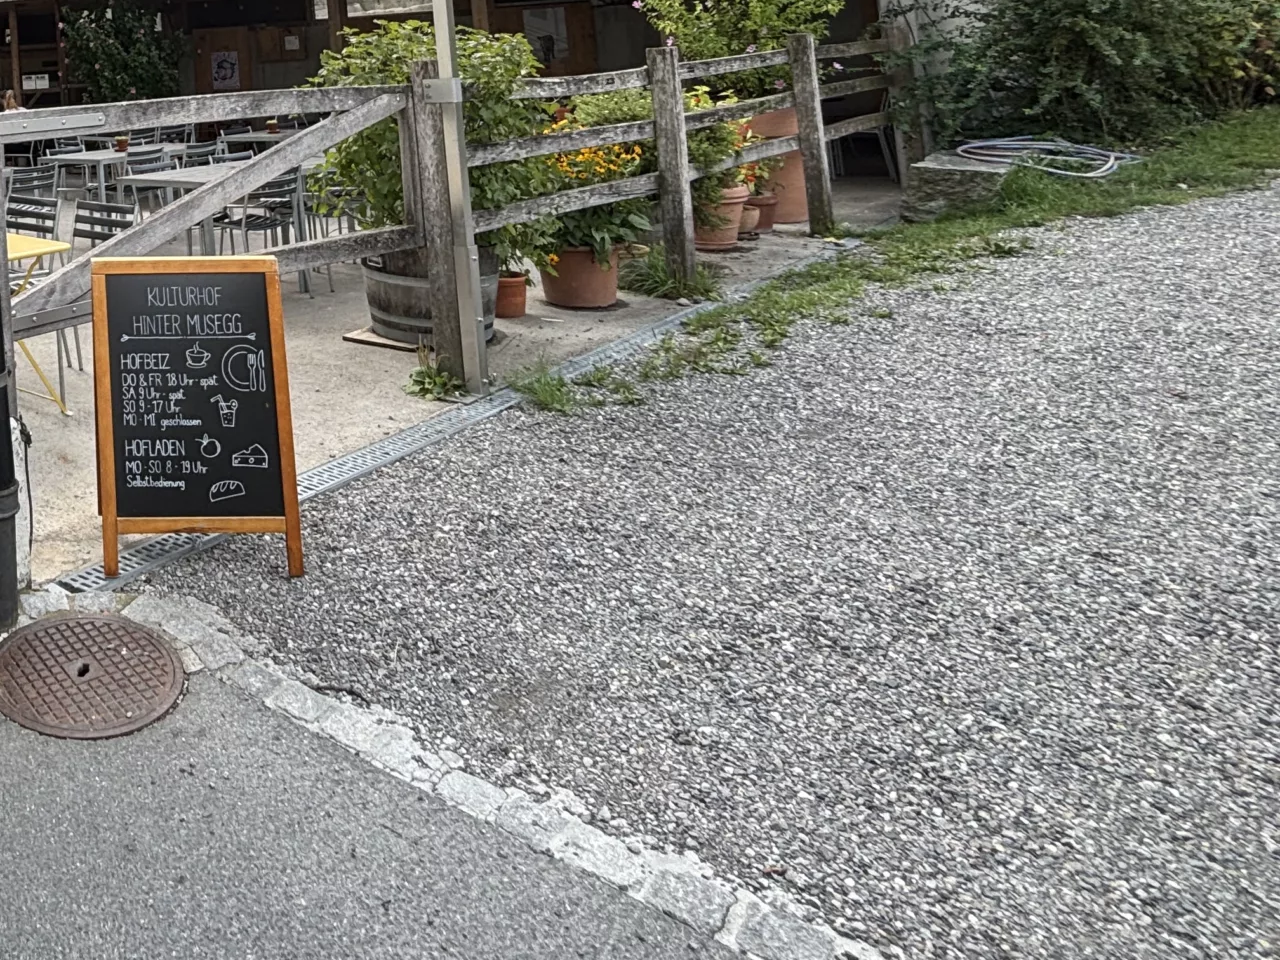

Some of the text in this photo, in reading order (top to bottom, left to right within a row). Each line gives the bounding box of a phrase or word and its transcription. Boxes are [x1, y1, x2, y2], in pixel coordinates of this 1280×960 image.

[147, 286, 222, 307] KULTURHOF
[132, 313, 242, 335] HINTER MUSEGG
[120, 352, 171, 370] HOFBEIZ
[121, 373, 137, 386] DO
[139, 373, 148, 387] &
[148, 373, 162, 386] FR
[165, 373, 177, 386] 18
[179, 373, 195, 386] Uhr
[200, 374, 219, 390] spät
[122, 386, 137, 400] SA
[138, 387, 144, 399] 9
[145, 387, 161, 399] Uhr
[168, 388, 187, 402] spät
[123, 400, 136, 413] SO
[138, 400, 145, 413] 9
[151, 400, 163, 413] 17
[165, 401, 181, 413] Uhr
[123, 413, 137, 426] MO
[143, 413, 156, 426] MI
[160, 413, 202, 431] geschlossen
[124, 439, 186, 457] HOFLADEN
[125, 460, 142, 474] MO
[148, 460, 162, 474] SO
[165, 460, 172, 474] 8
[180, 460, 191, 474] 19
[192, 461, 208, 474] Uhr
[126, 474, 186, 491] Selbstbedienung
